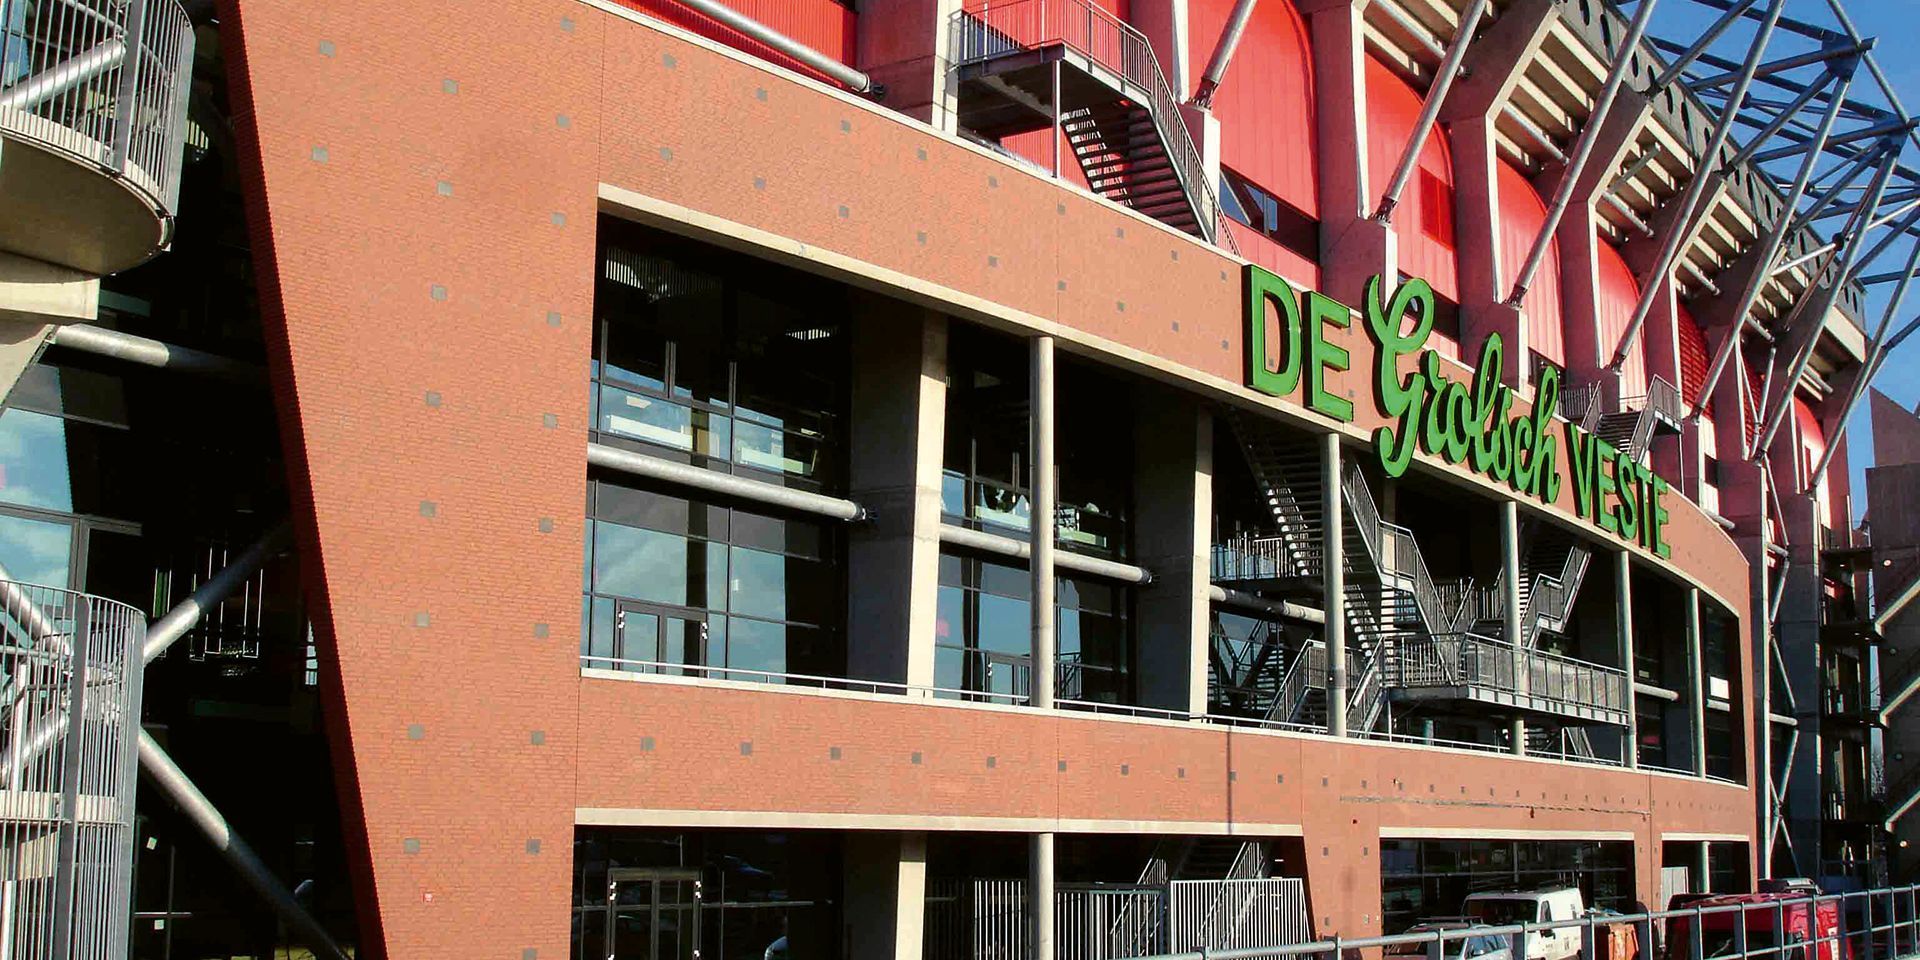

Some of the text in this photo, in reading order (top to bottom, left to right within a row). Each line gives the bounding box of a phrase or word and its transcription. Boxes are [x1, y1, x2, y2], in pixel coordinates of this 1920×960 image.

[1244, 264, 1671, 559] DE Grolsch VESTE
